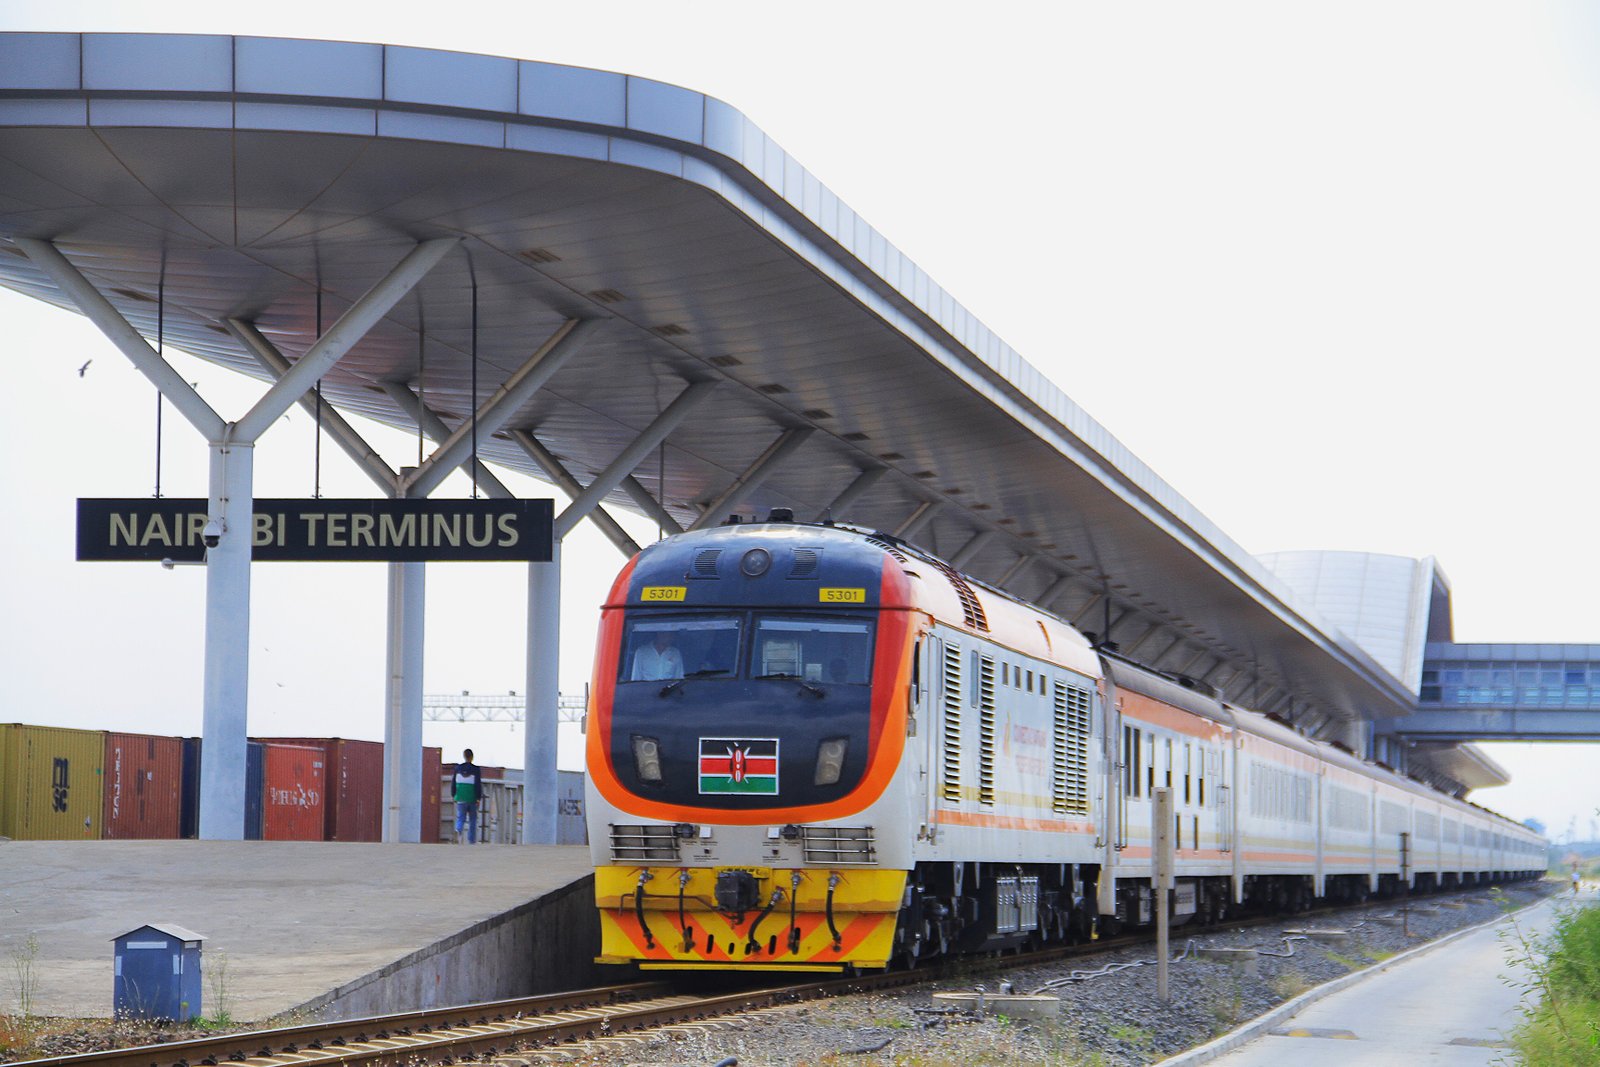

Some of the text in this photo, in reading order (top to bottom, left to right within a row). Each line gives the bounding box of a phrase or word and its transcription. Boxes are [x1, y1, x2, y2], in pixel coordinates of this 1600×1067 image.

[108, 512, 520, 548] NAIRBI TERMINUS
[649, 589, 679, 599] 5301
[827, 590, 858, 601] 5301
